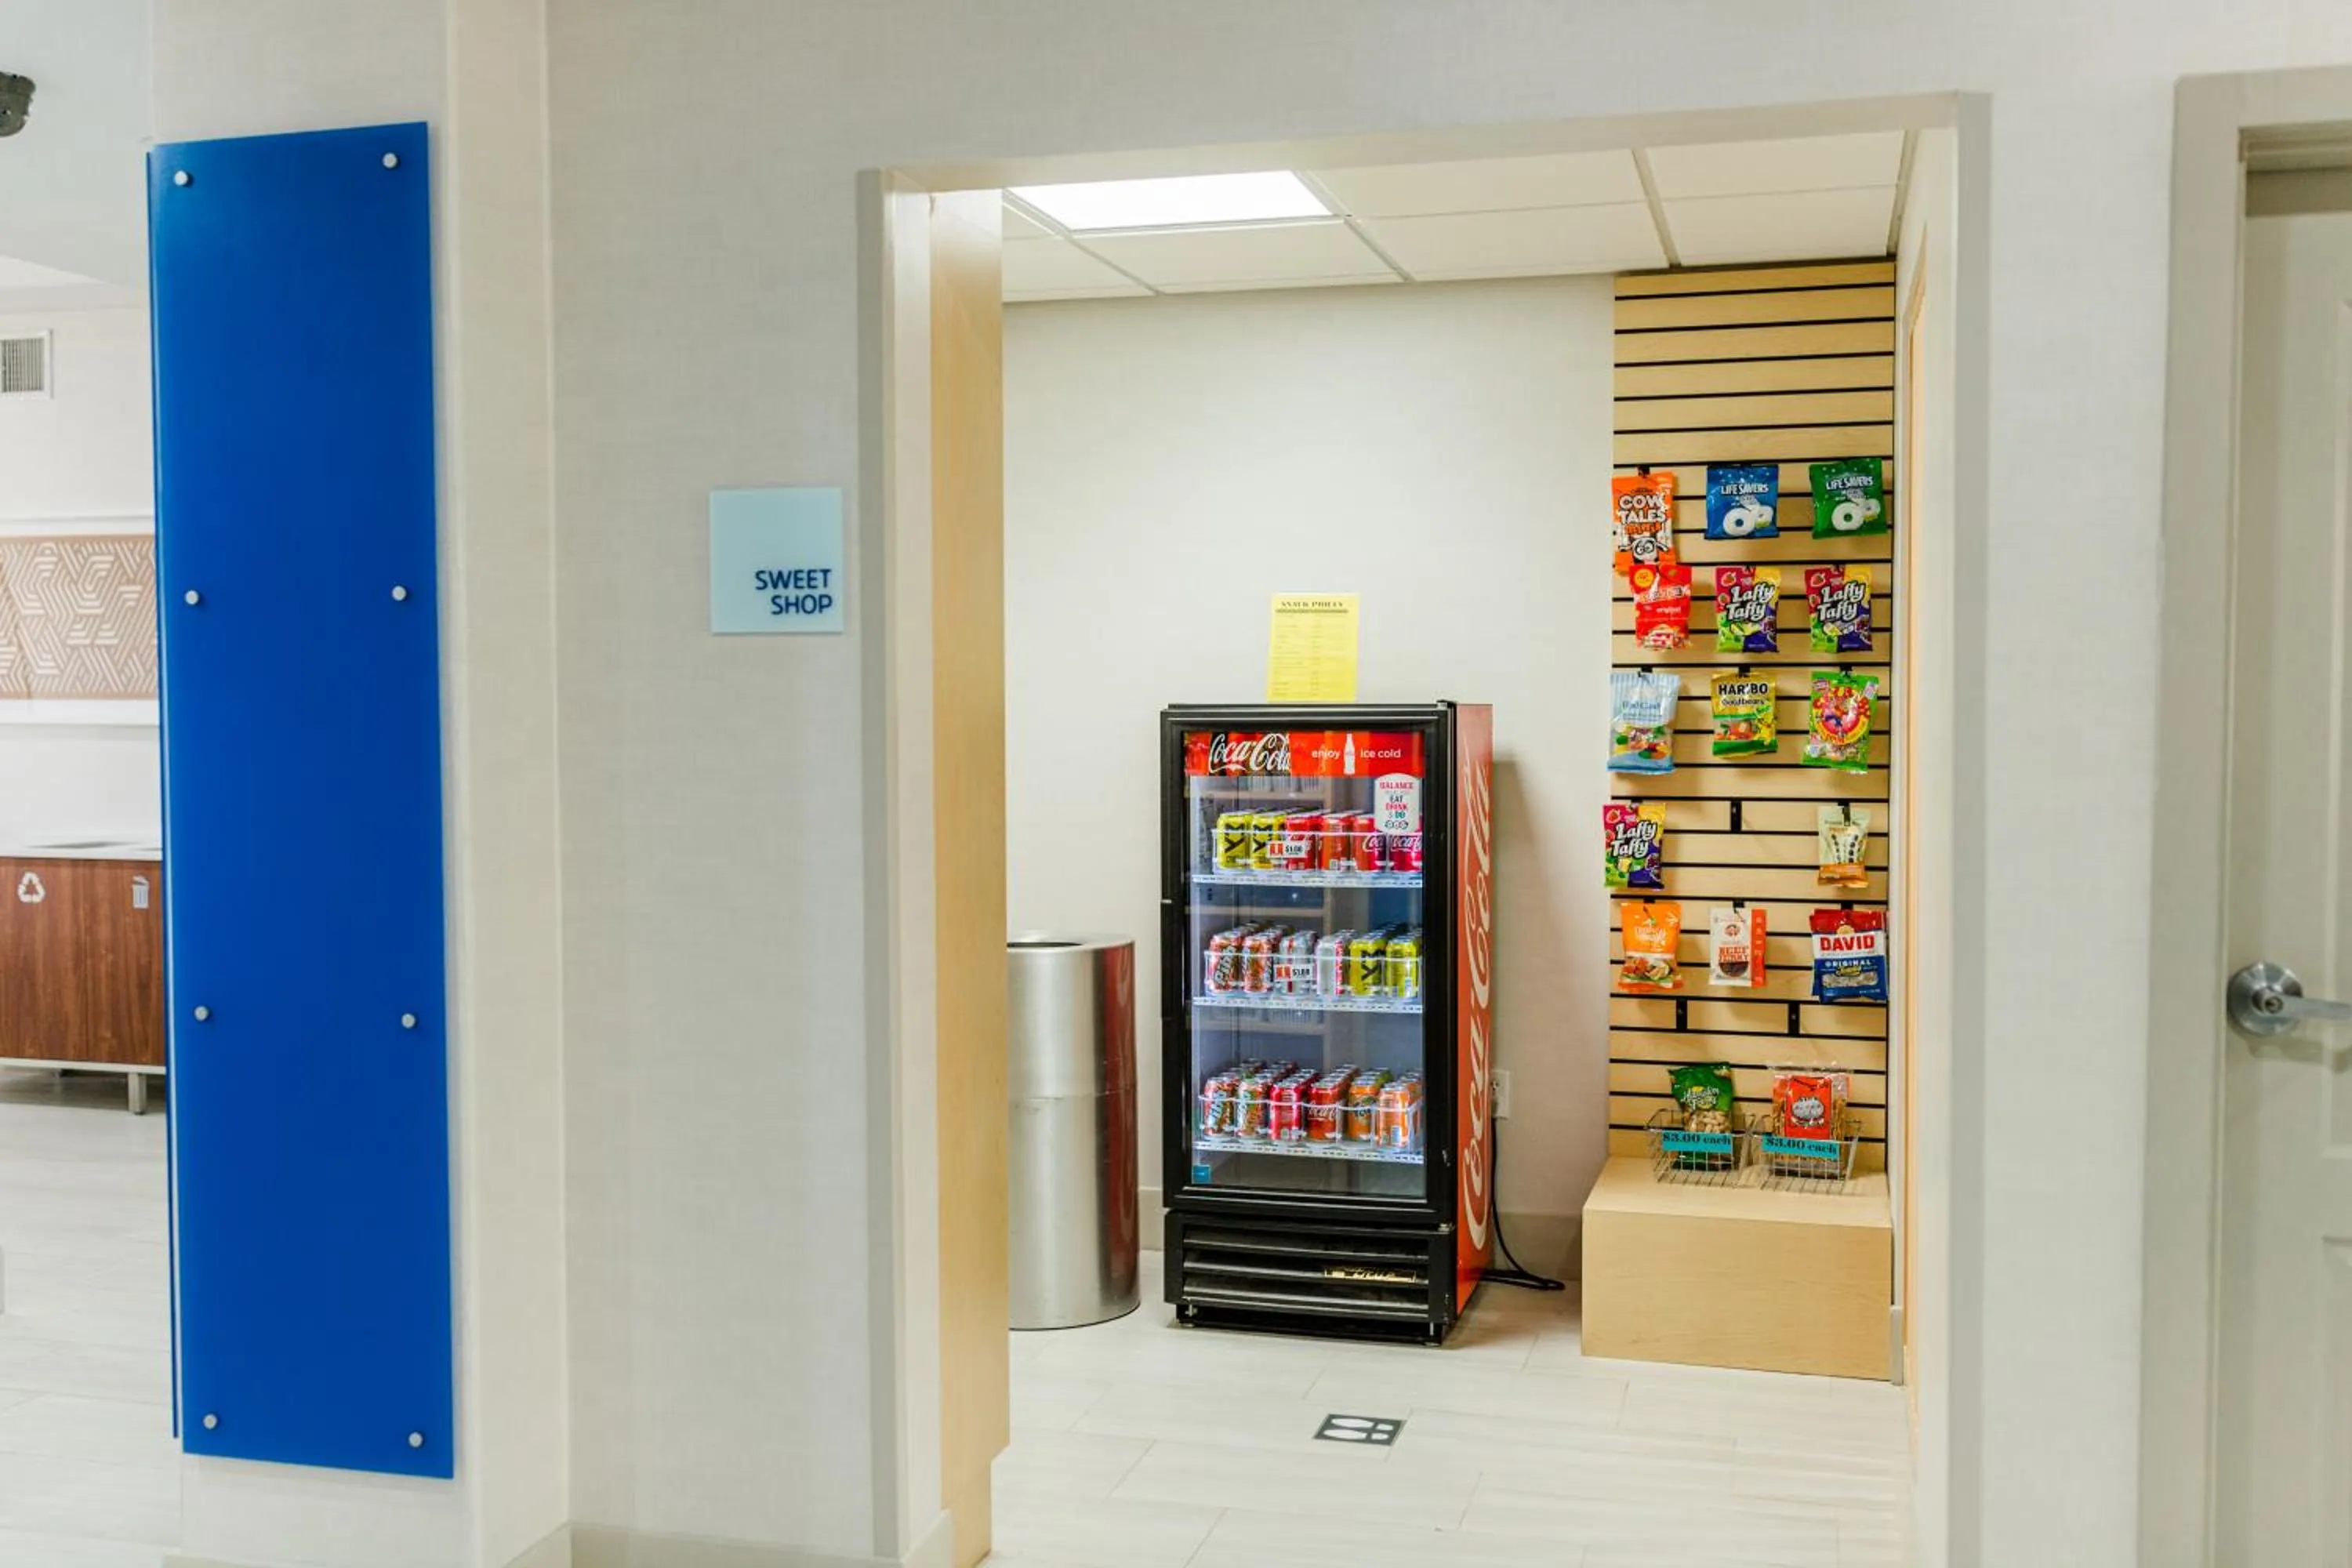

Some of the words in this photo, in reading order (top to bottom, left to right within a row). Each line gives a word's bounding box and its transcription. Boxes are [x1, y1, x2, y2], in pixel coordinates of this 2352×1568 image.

[1721, 485, 1738, 495] LIFE
[1738, 483, 1769, 495] SAVERS
[1826, 479, 1842, 490] LIFE
[1842, 476, 1873, 488] SAVERS
[1619, 495, 1664, 510] COW
[1619, 509, 1666, 524] TALES
[754, 568, 832, 590] SWEET
[1731, 583, 1775, 603] Laffy
[1821, 582, 1865, 603] Laffy
[771, 593, 833, 615] SHOP
[1726, 601, 1766, 621] Taffy
[1817, 601, 1857, 621] Taffy
[1312, 748, 1341, 760] enjoy
[1360, 748, 1376, 758] ice
[1377, 748, 1402, 758] cold
[1616, 821, 1657, 841] Laffy
[1610, 838, 1649, 858] Taffy
[1820, 934, 1875, 952] DAVID
[1825, 959, 1872, 968] ORIGINAL
[1703, 1134, 1731, 1145] each
[1766, 1136, 1806, 1149] $3.00
[1807, 1143, 1837, 1154] each
